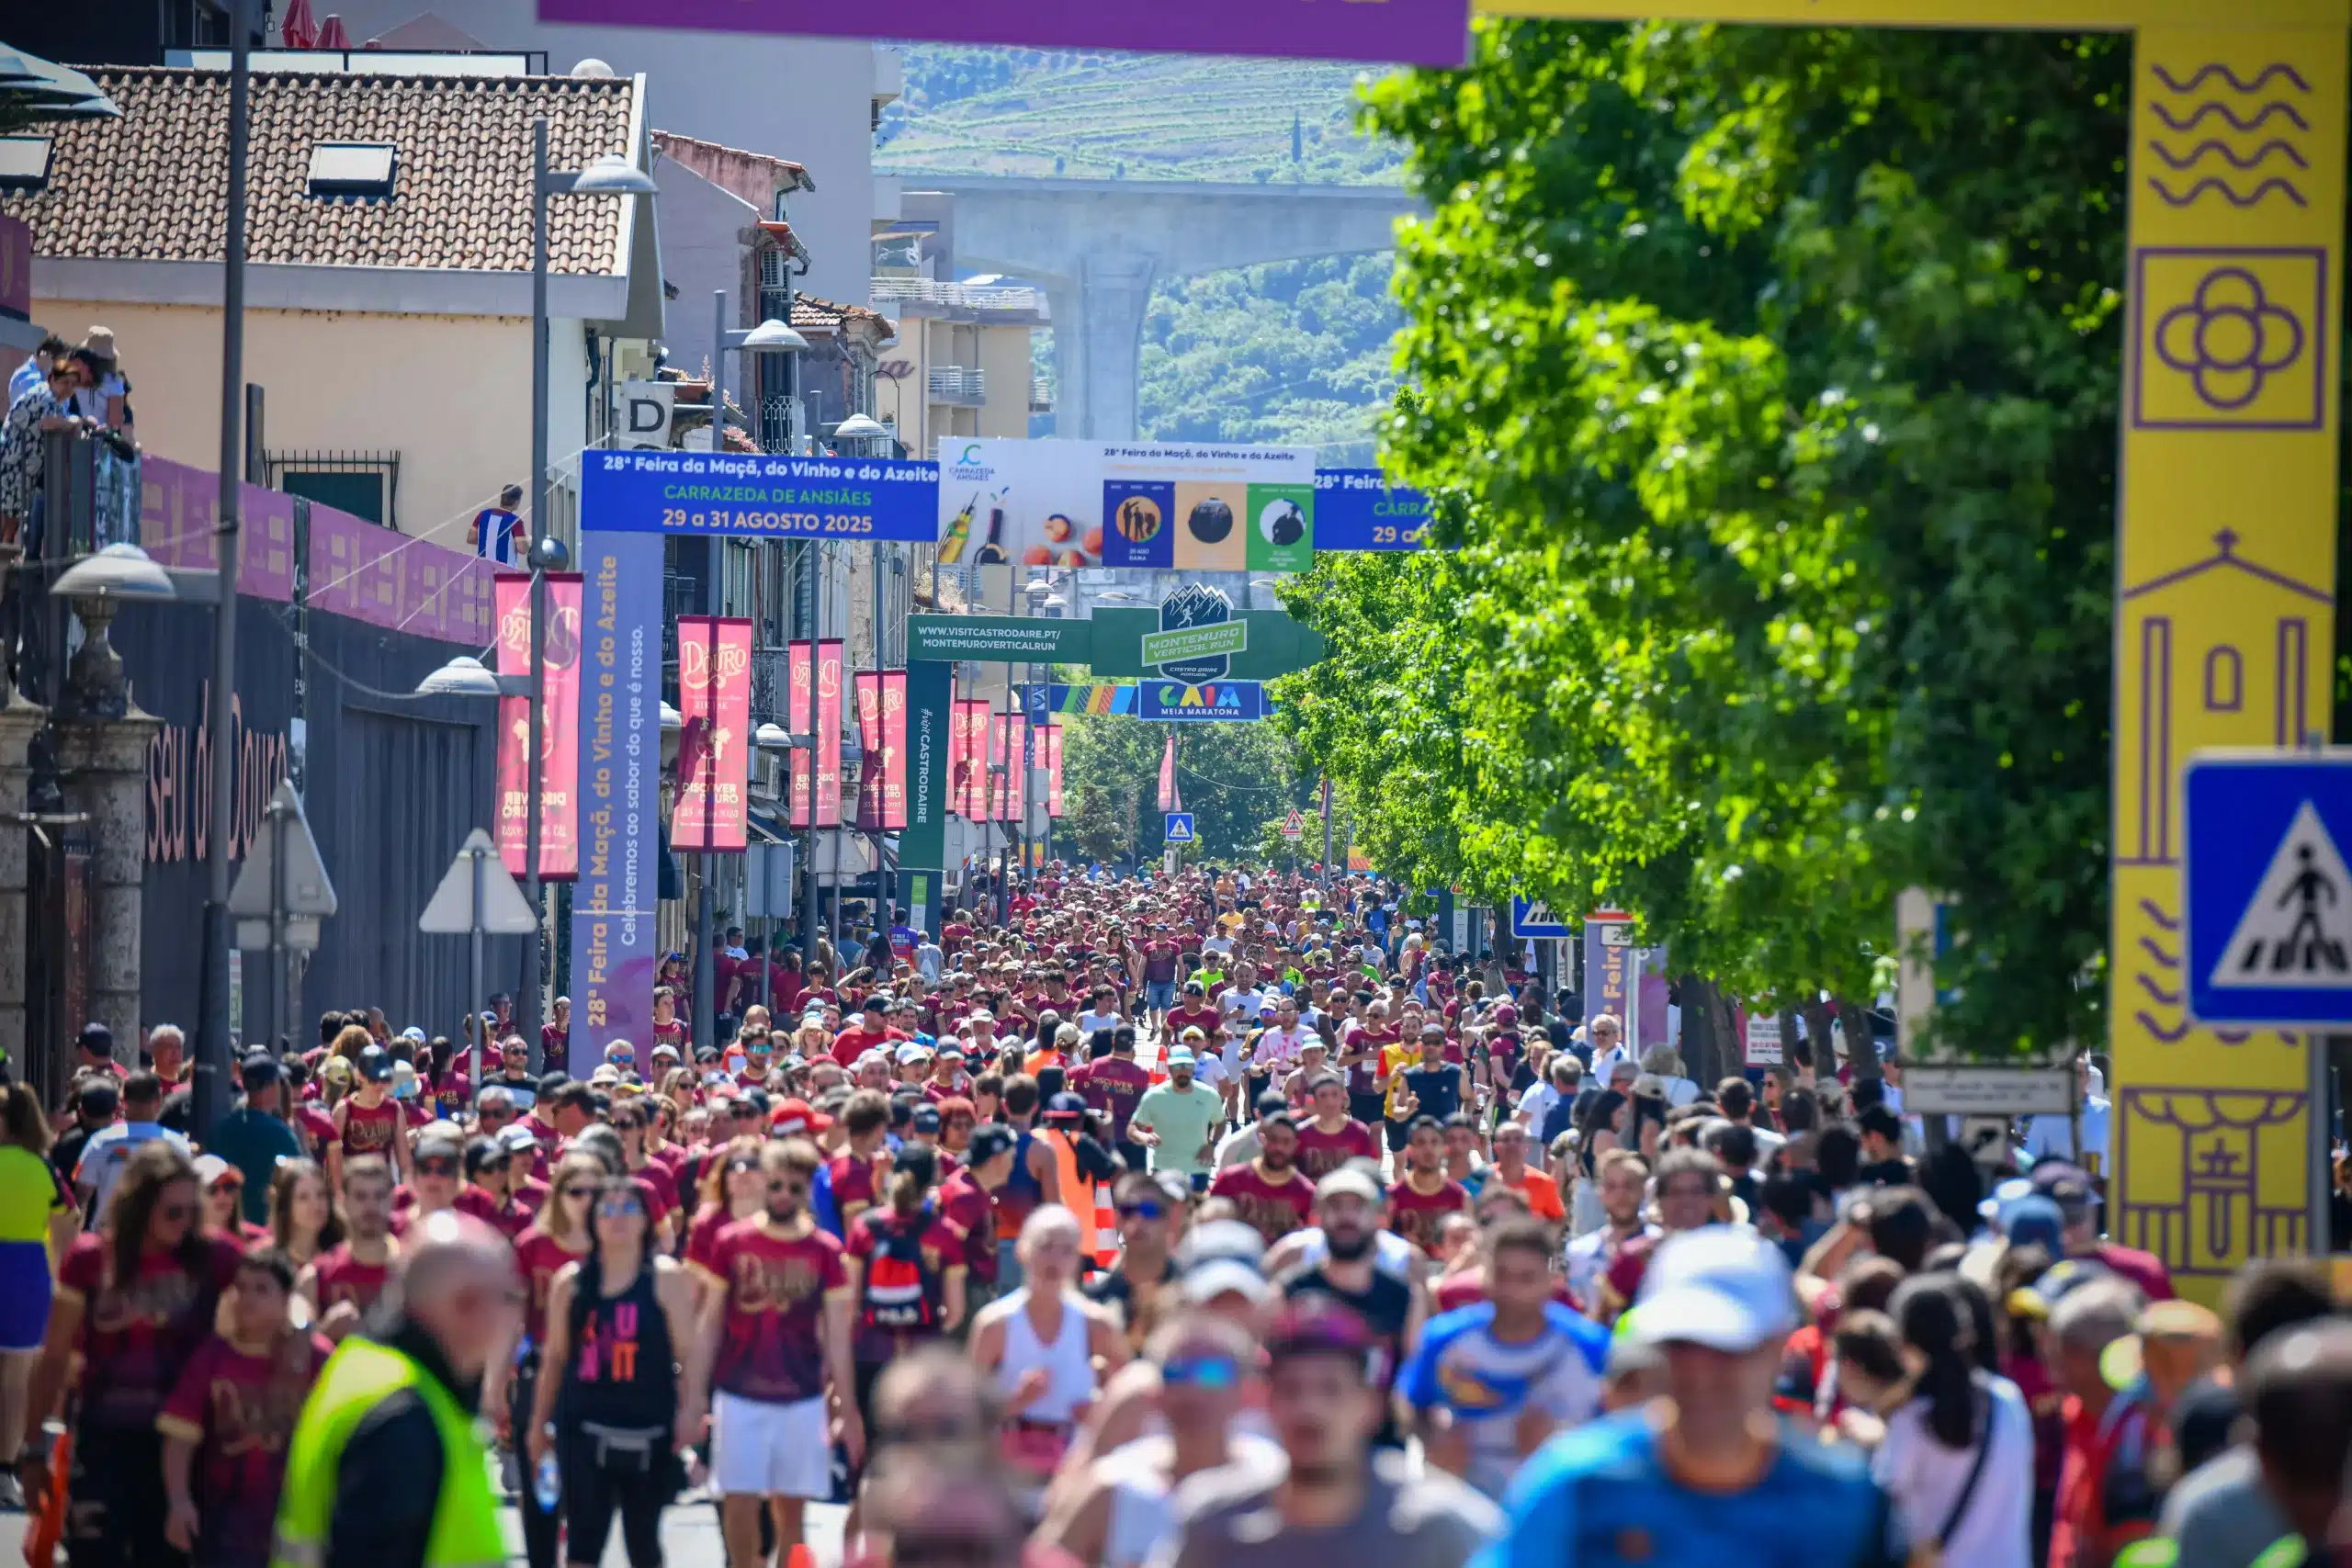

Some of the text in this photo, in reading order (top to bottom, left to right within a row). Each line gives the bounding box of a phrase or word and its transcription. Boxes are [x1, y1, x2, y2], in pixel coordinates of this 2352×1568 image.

[1122, 448, 1147, 457] Feira
[1148, 450, 1162, 458] da
[1164, 448, 1193, 460] Maçã,
[1196, 450, 1209, 458] do
[1211, 450, 1239, 459] Vinho
[1250, 451, 1262, 460] do
[1263, 452, 1295, 461] Azeite
[635, 456, 679, 473] Feira
[683, 458, 705, 474] da
[709, 459, 762, 480] Maçã,
[765, 462, 788, 478] do
[792, 461, 841, 479] Vinho
[844, 468, 855, 479] e
[858, 464, 882, 480] do
[884, 464, 939, 483] Azeite
[664, 485, 872, 506] CARRAZEDA DE ANSIÃES
[1374, 502, 1431, 516] CARRA
[662, 509, 873, 533] 29 a 31 AGOSTO 2025
[1373, 526, 1396, 543] 29
[918, 626, 1061, 640] WWW.VISITCASTRODAIRE.PT/
[1148, 627, 1239, 651] MONTEMURO
[922, 638, 1056, 651] MONTEMUROVERTICALRUN
[1153, 637, 1236, 658] VERTICAL RUN
[1161, 707, 1239, 716] MEIA MARATONA
[917, 708, 933, 823] #visitCASTRODAIRE
[142, 721, 186, 863] seu
[587, 555, 616, 1027] 28ª Feira da Maçã, do Vinho e do Azeite
[621, 625, 645, 946] Celebremos ao sabor do que é nosso.
[864, 784, 899, 792] DISCVER
[1092, 1076, 1134, 1089] DISCVER
